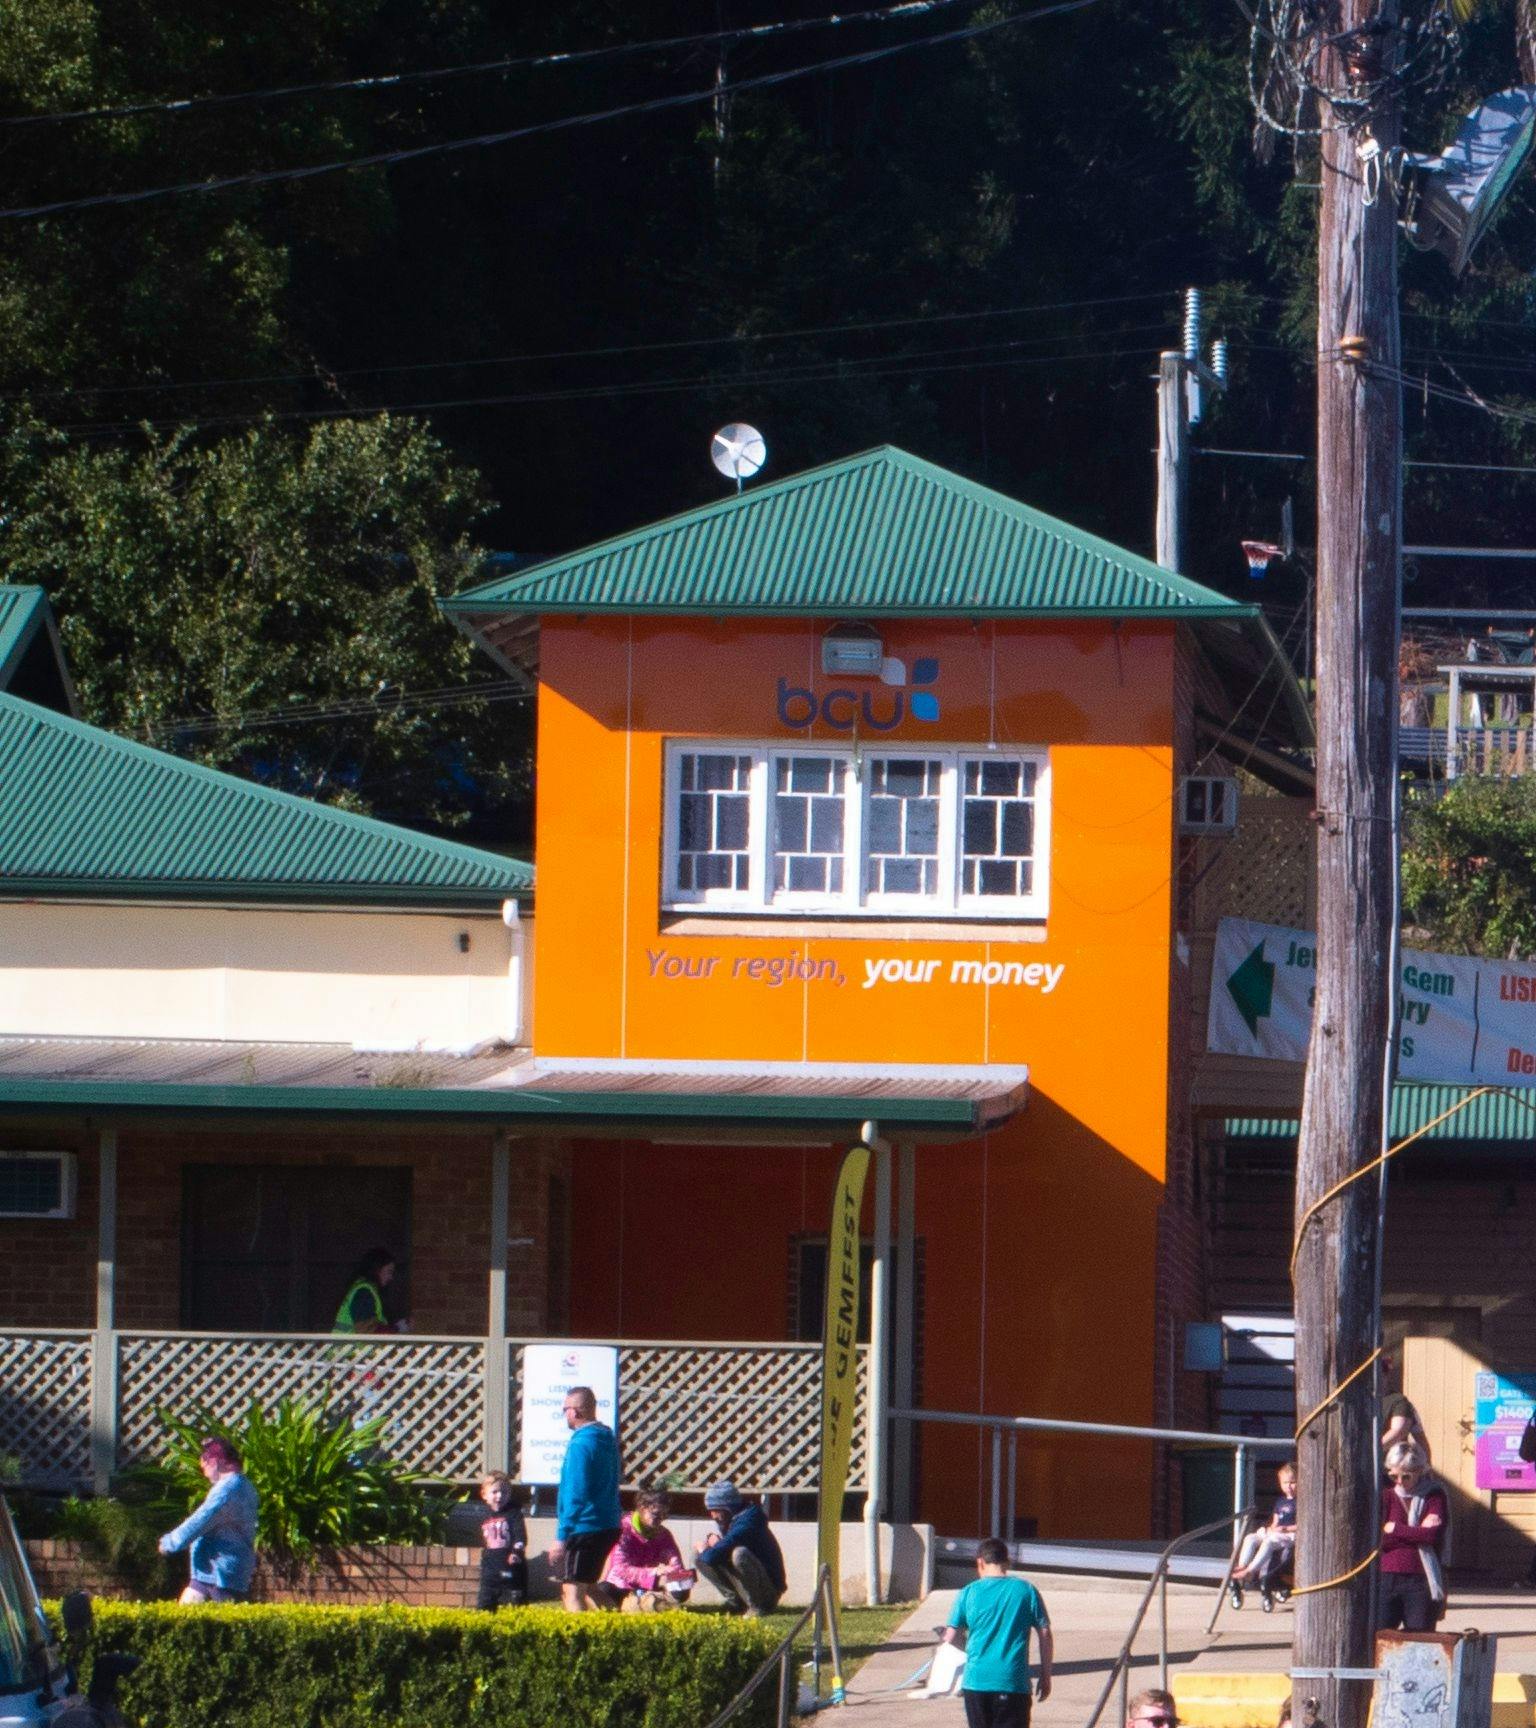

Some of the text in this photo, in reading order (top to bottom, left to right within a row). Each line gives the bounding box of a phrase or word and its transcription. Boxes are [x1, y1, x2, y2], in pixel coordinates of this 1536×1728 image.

[777, 677, 905, 730] bcu
[646, 948, 1064, 993] Your region, your money
[1403, 965, 1455, 996] Gem
